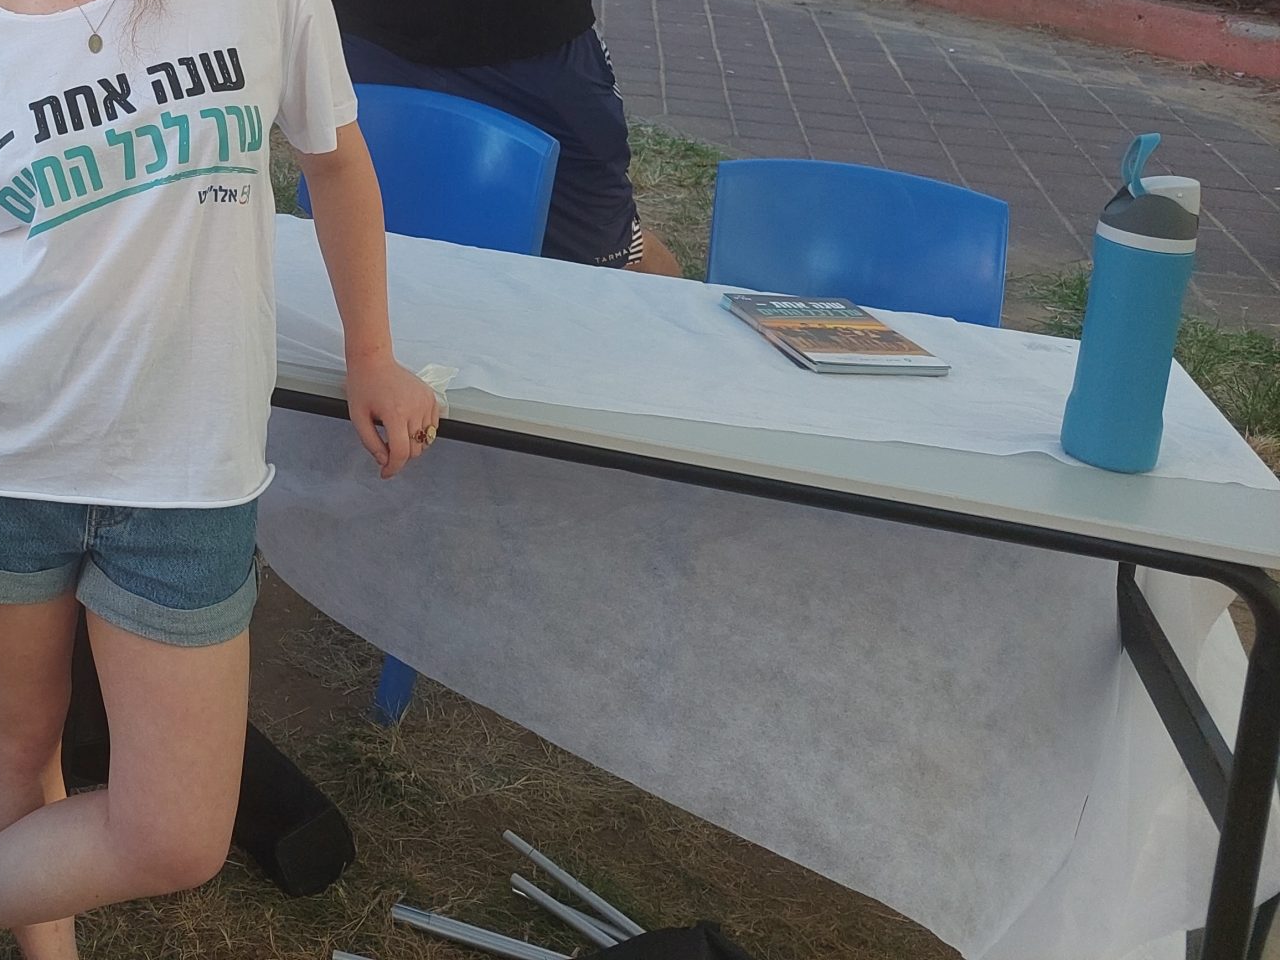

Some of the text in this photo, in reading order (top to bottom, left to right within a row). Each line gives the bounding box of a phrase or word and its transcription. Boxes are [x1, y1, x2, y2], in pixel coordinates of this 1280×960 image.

[146, 47, 246, 105] שנה
[29, 73, 137, 144] אחת
[199, 105, 263, 162] ערך
[105, 111, 190, 180] לכל
